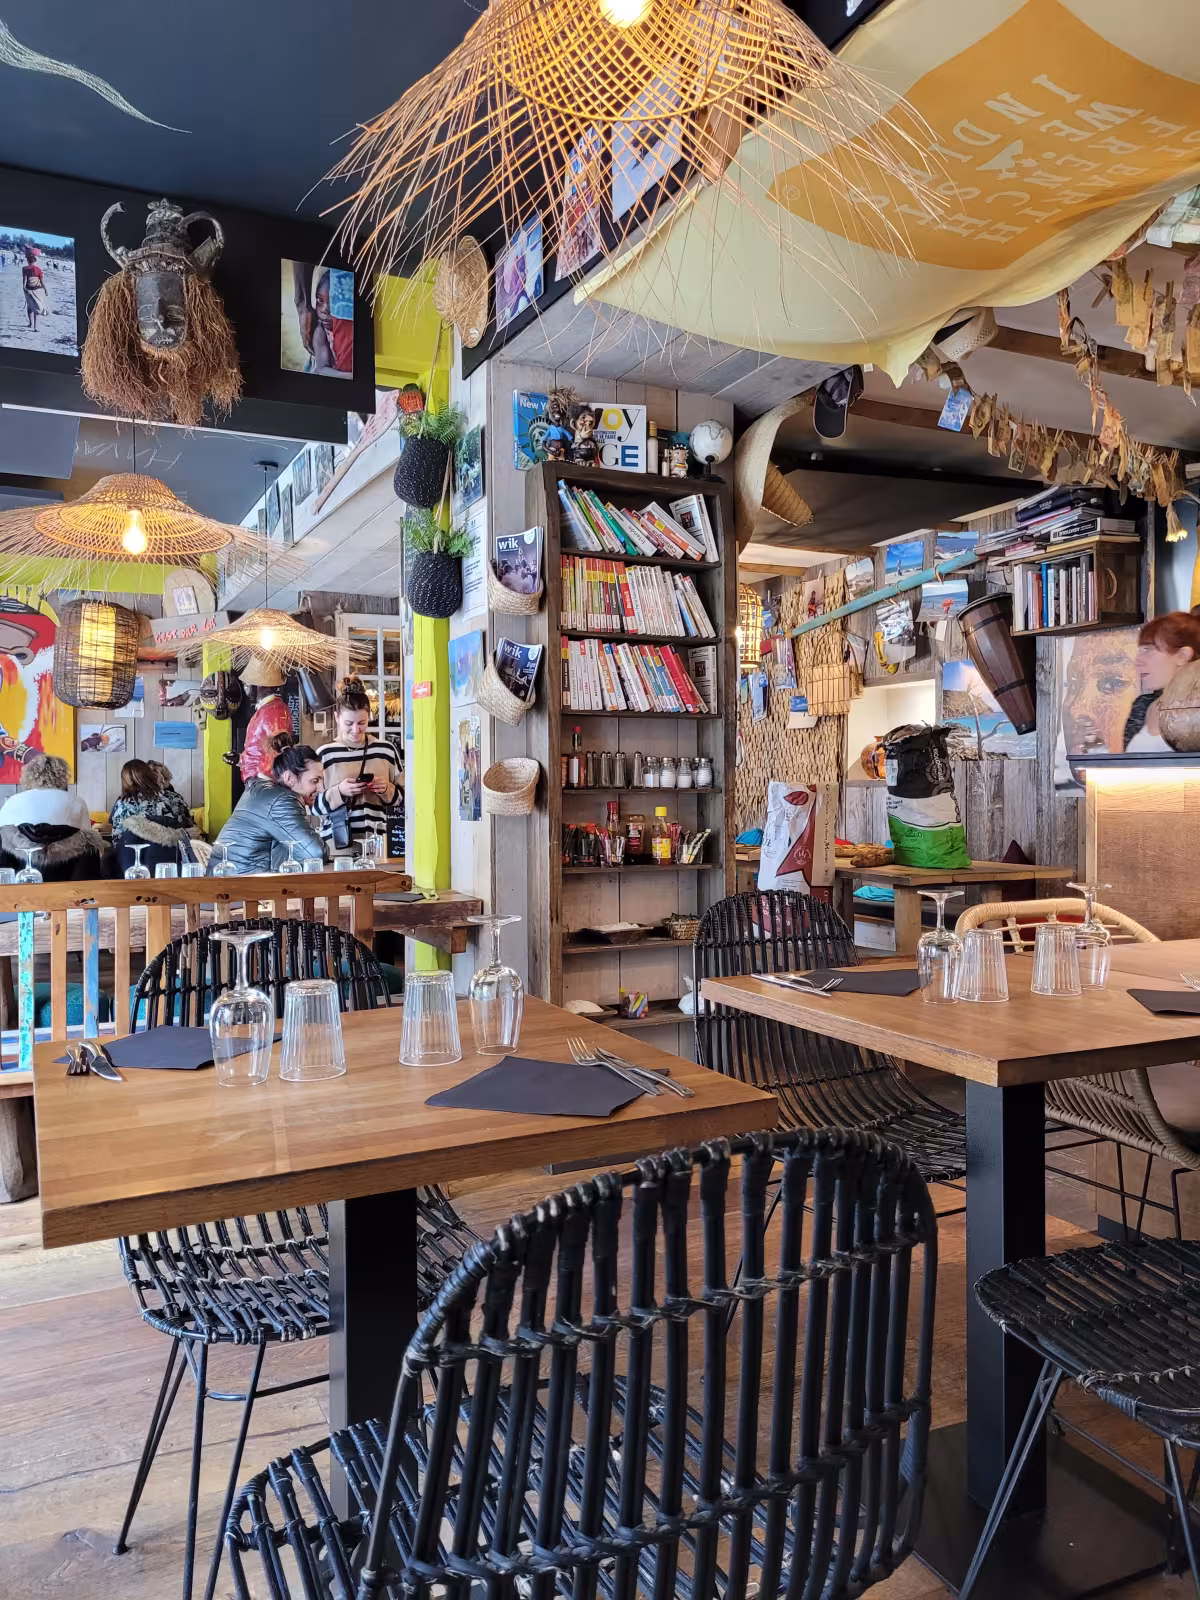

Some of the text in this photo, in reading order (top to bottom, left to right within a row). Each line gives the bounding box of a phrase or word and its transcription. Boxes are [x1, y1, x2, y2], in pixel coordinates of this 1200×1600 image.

[520, 398, 539, 409] New
[628, 525, 646, 545] Irlande
[498, 537, 519, 550] wik
[504, 643, 522, 659] wik
